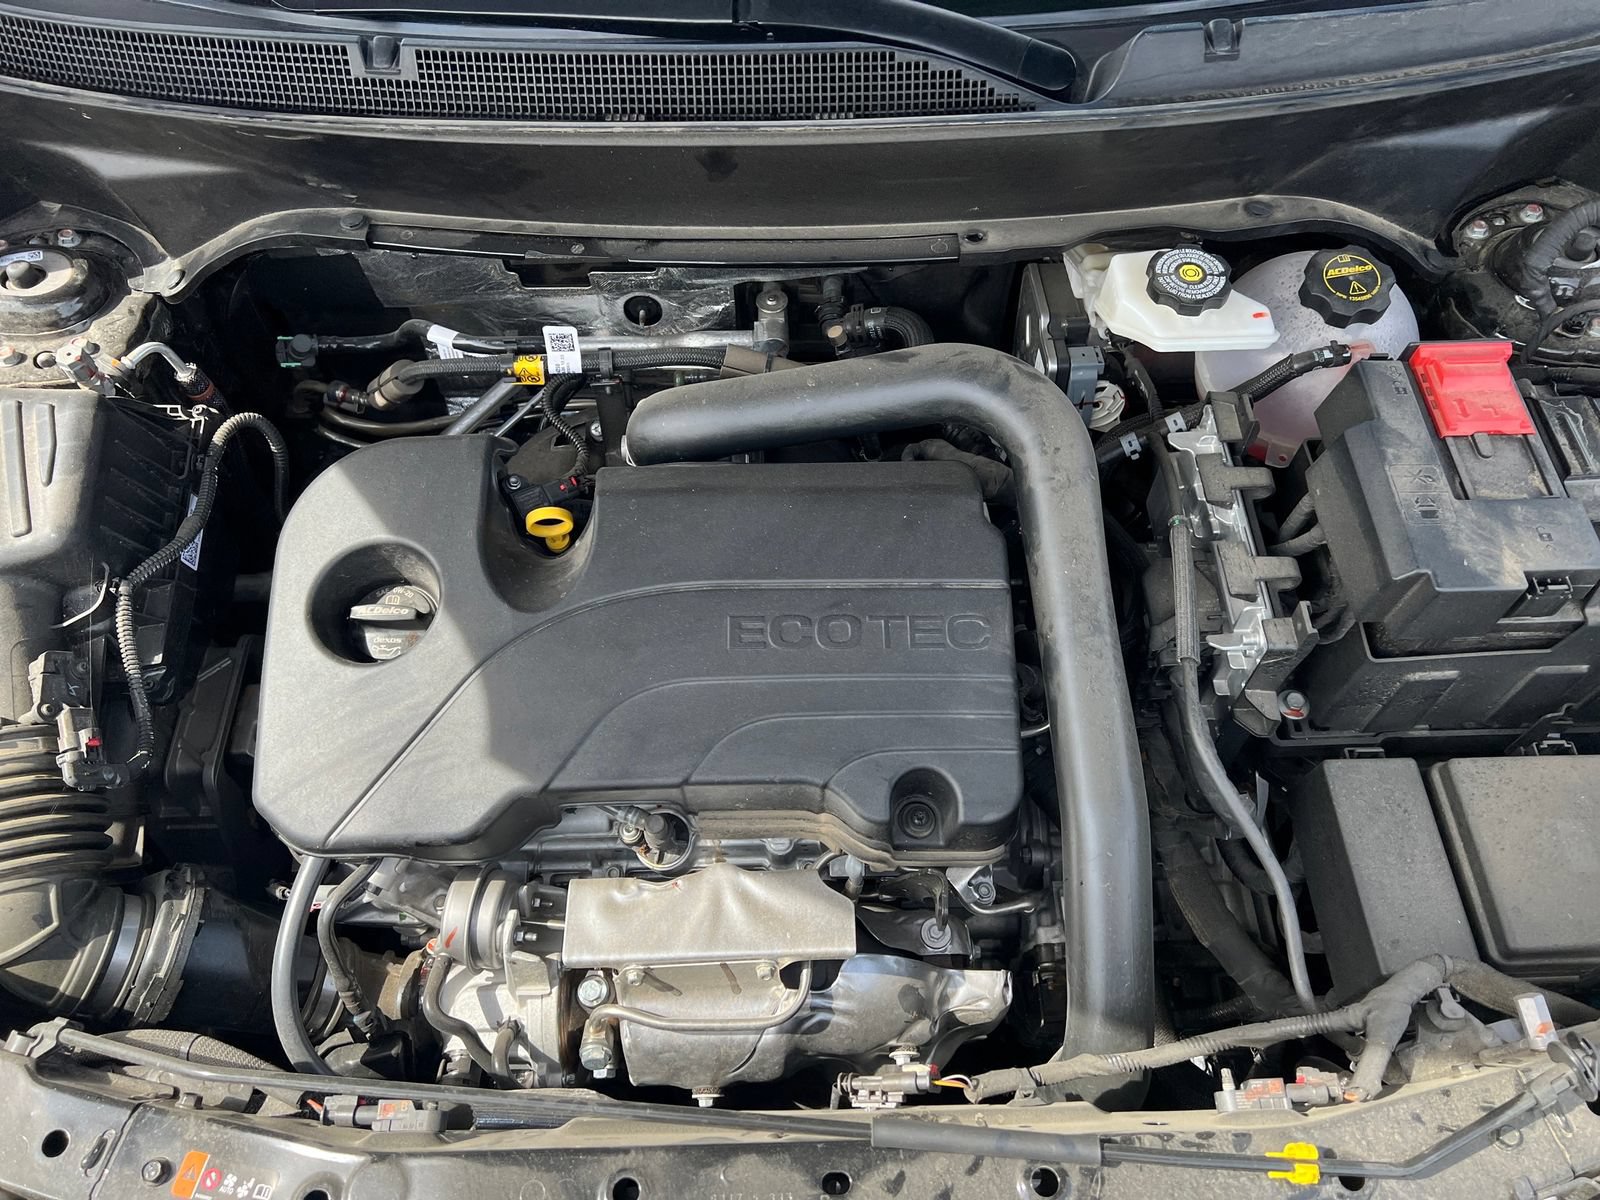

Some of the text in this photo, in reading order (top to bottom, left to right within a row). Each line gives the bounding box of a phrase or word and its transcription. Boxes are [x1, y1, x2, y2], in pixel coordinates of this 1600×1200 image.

[1327, 265, 1372, 276] ACDelco
[359, 606, 409, 615] ACDelco
[726, 612, 991, 651] ECOTEC
[374, 636, 402, 644] dexos
